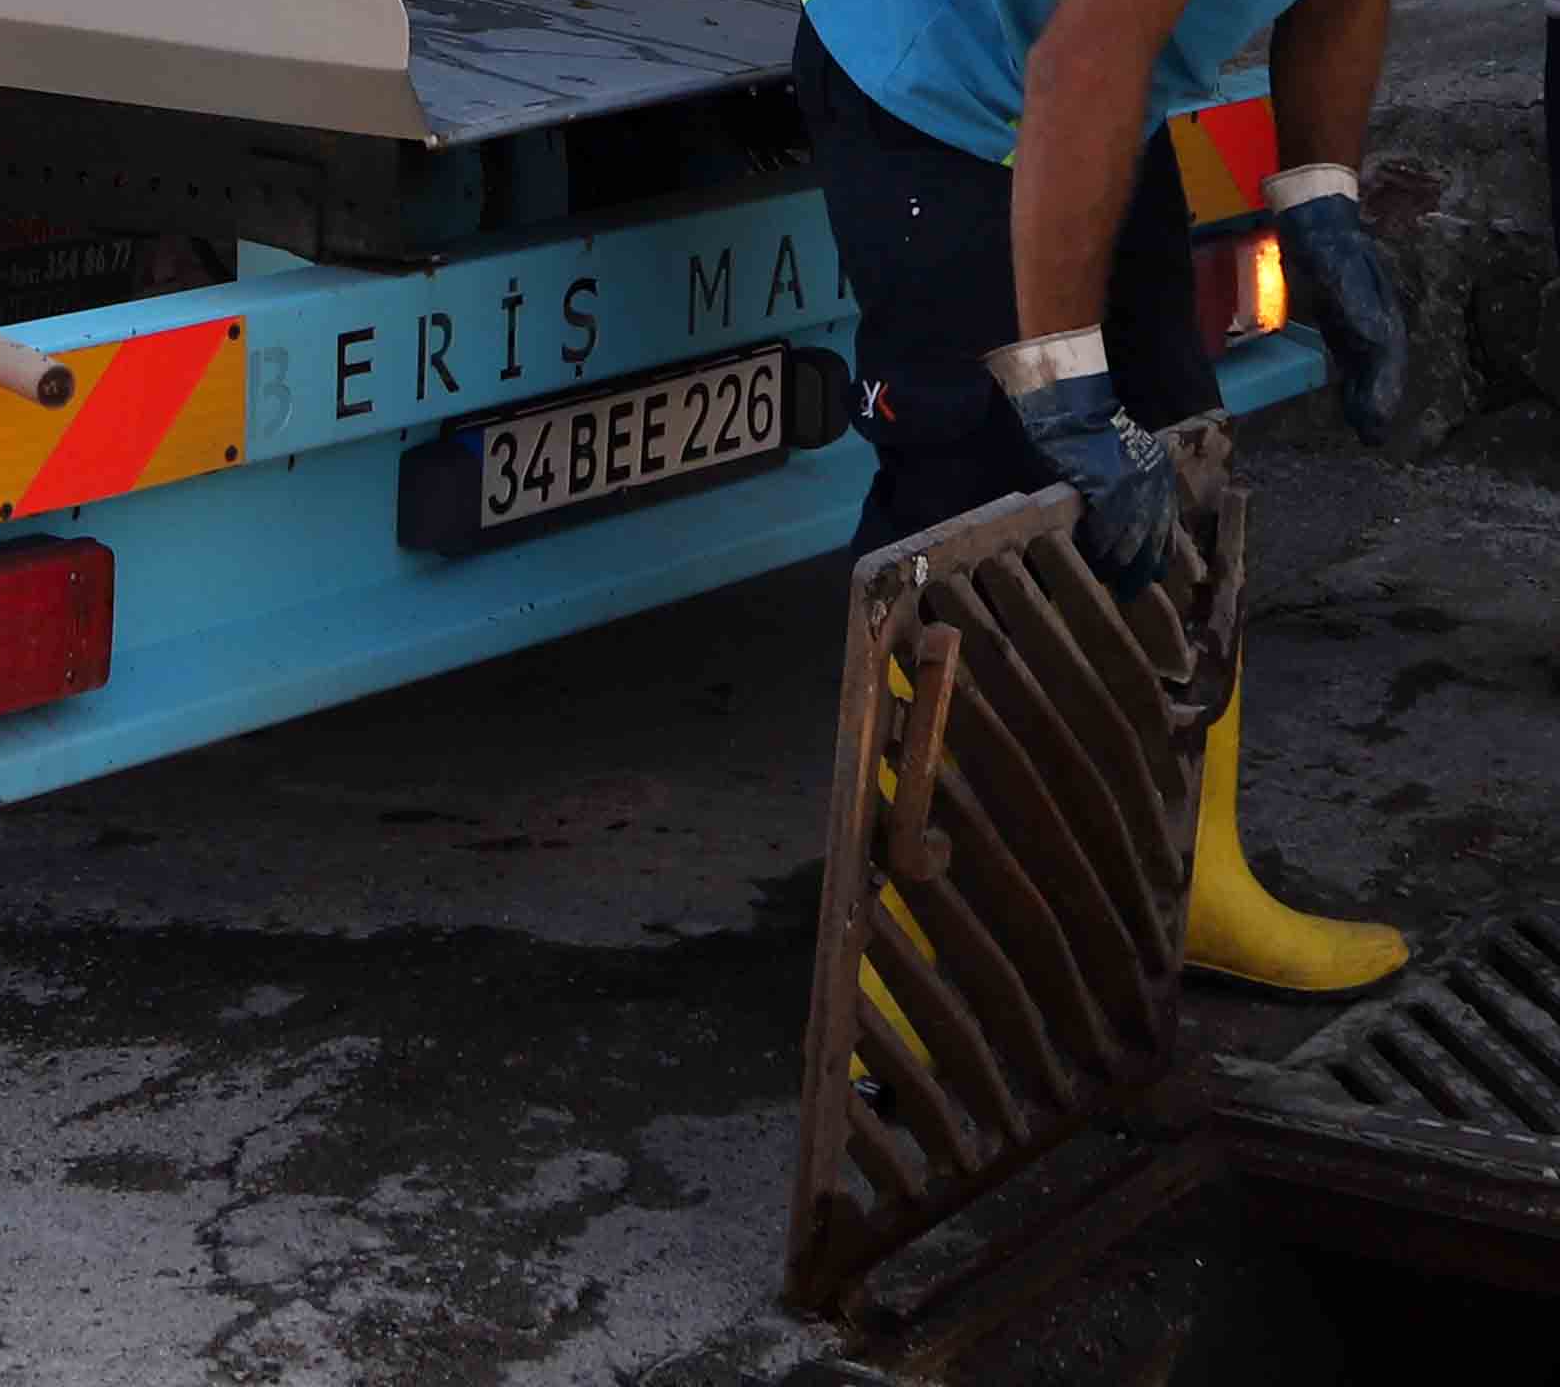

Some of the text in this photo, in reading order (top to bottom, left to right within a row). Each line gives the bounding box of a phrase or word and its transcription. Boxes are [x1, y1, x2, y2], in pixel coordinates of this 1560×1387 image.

[486, 431, 555, 517] 34
[567, 392, 667, 498] BEE
[679, 364, 776, 465] 226
